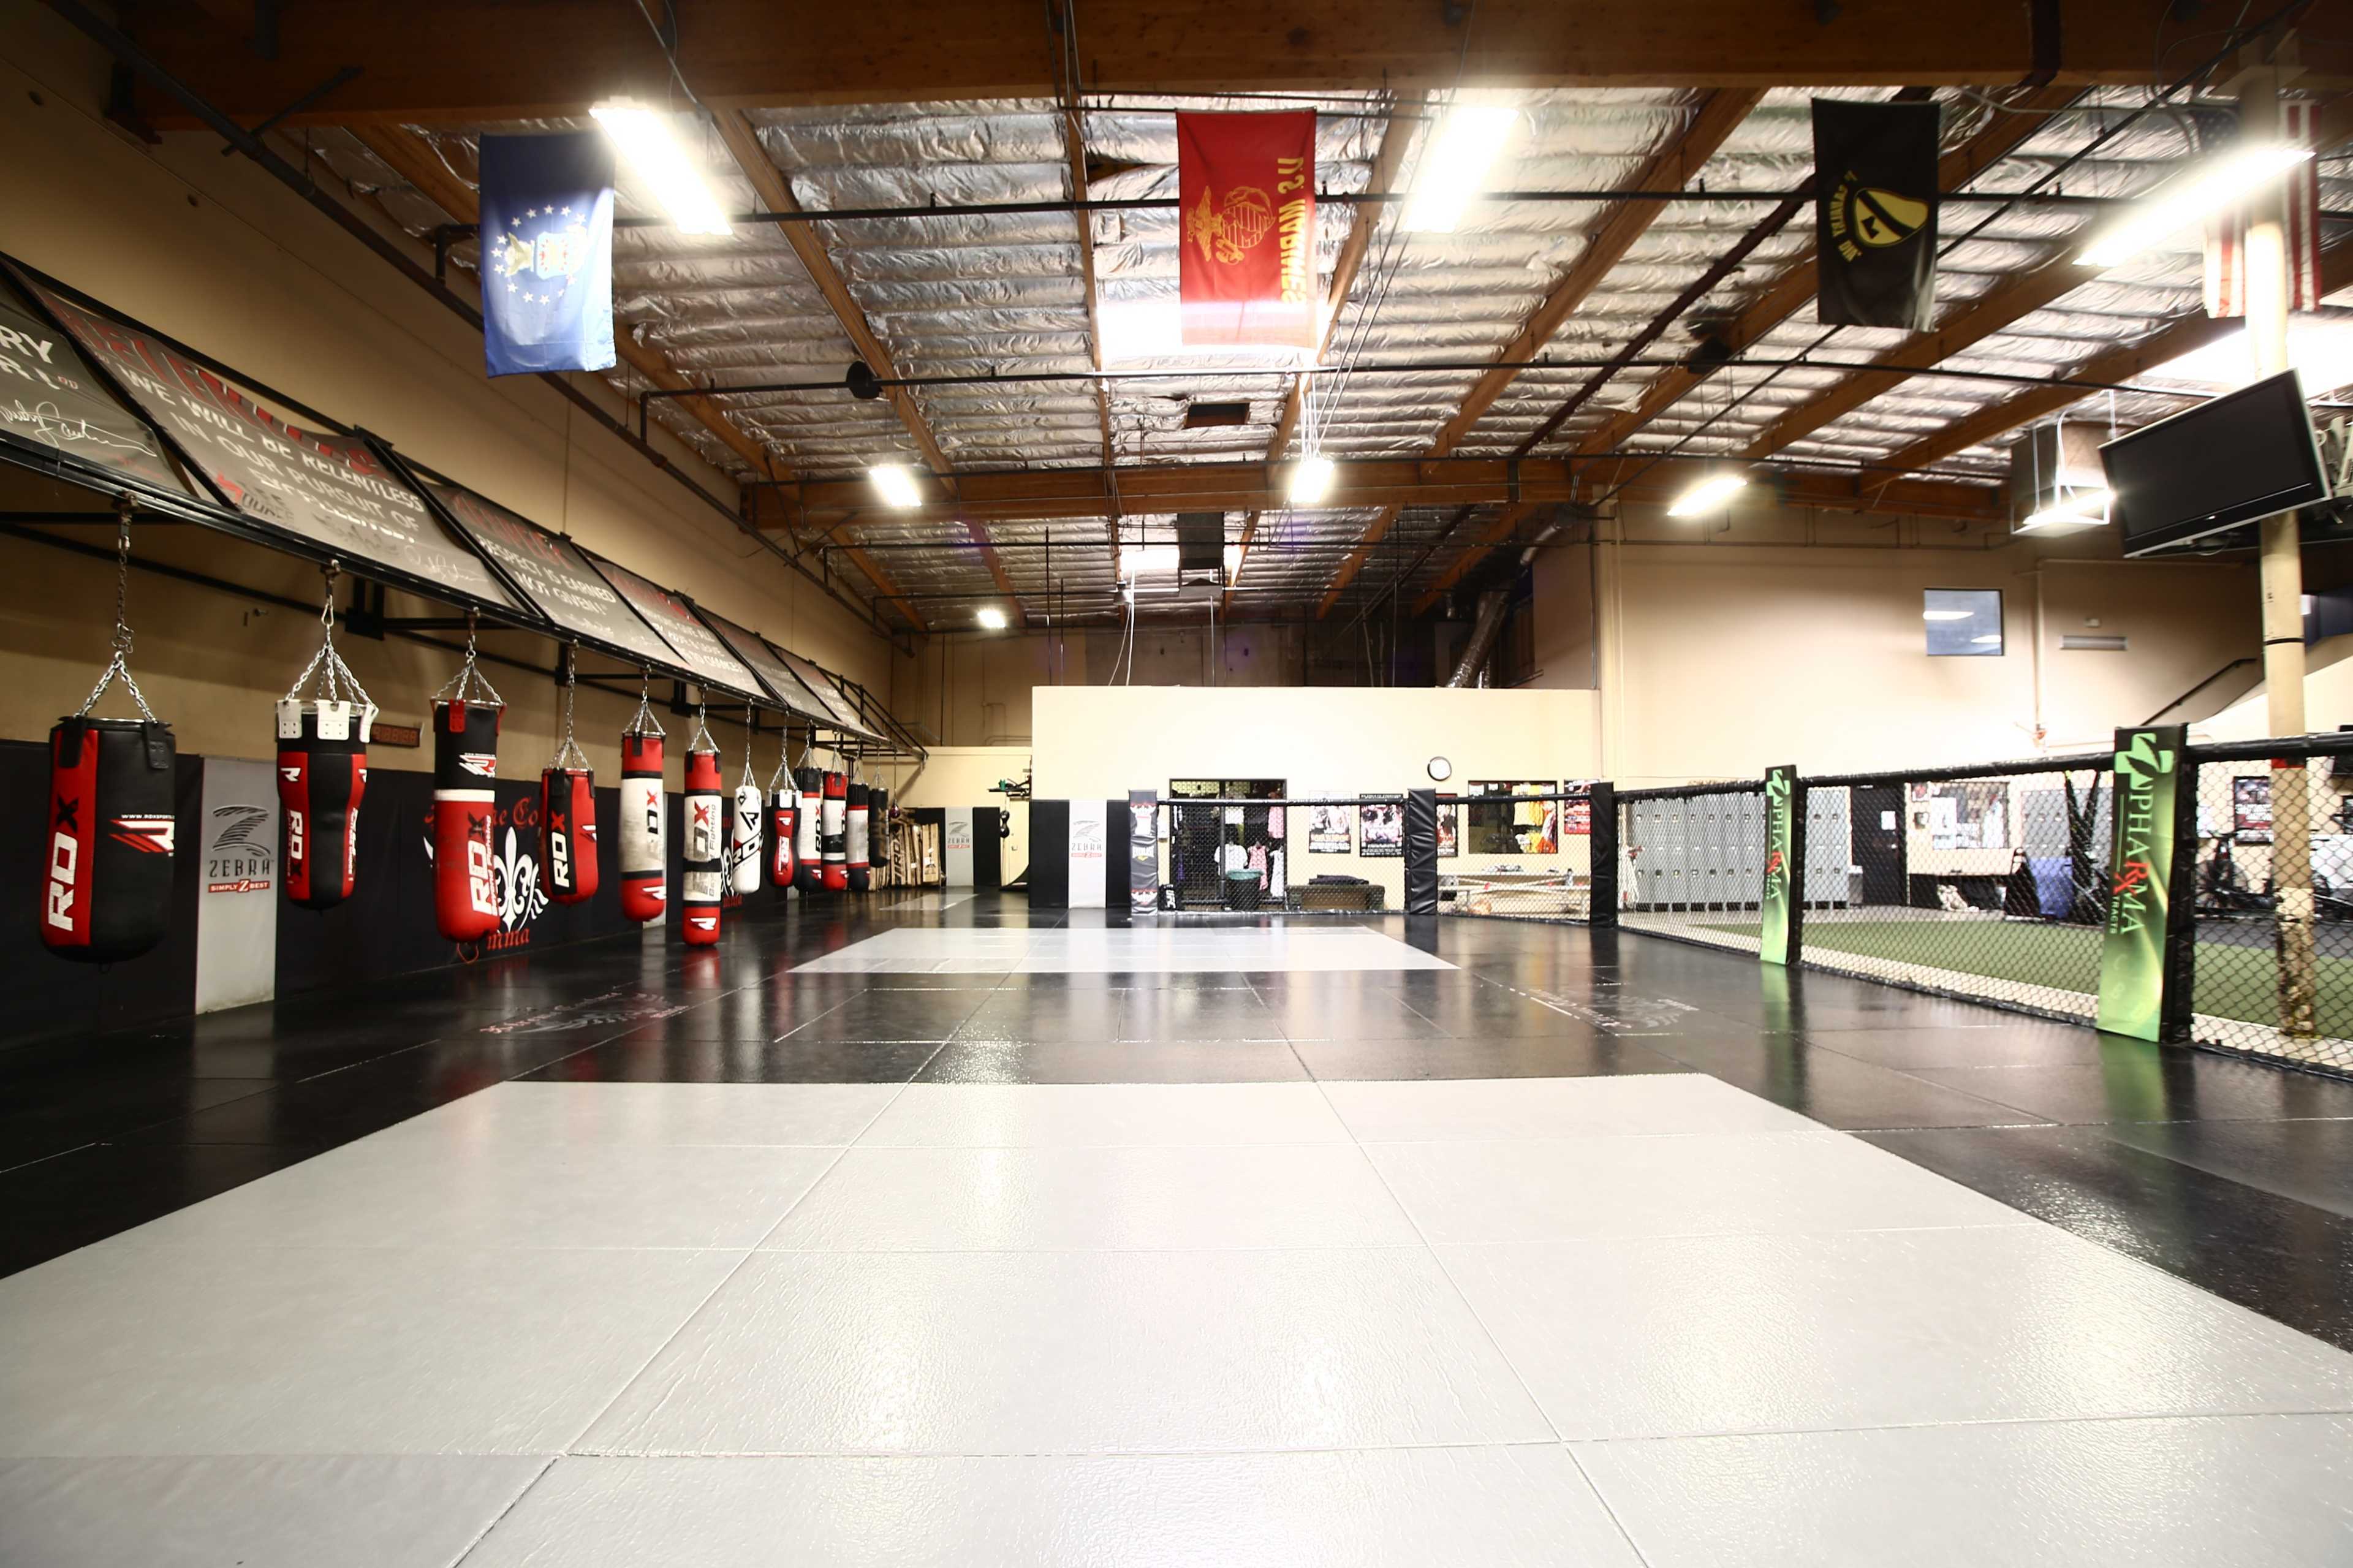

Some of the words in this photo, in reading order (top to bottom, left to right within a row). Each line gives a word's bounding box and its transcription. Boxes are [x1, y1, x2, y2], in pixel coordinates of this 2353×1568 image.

[116, 363, 176, 406] WE
[181, 396, 254, 442] WILL
[261, 434, 294, 460] BE
[301, 452, 424, 513] RELENTLESS
[169, 411, 211, 442] IN
[216, 435, 283, 476] OUR
[286, 466, 385, 518] PURSUIT
[390, 510, 419, 531] OF
[476, 532, 542, 577] RESPECT
[543, 567, 561, 585] IS
[561, 574, 616, 603] EARNED
[513, 570, 550, 597] NOT
[47, 797, 80, 932] RDX
[209, 858, 270, 877] ZEBRA
[289, 809, 303, 879] RDX
[467, 810, 493, 915] RDX
[551, 809, 570, 888] RDX
[781, 836, 789, 871] RDX
[238, 879, 250, 892] Z
[487, 928, 530, 951] mma
